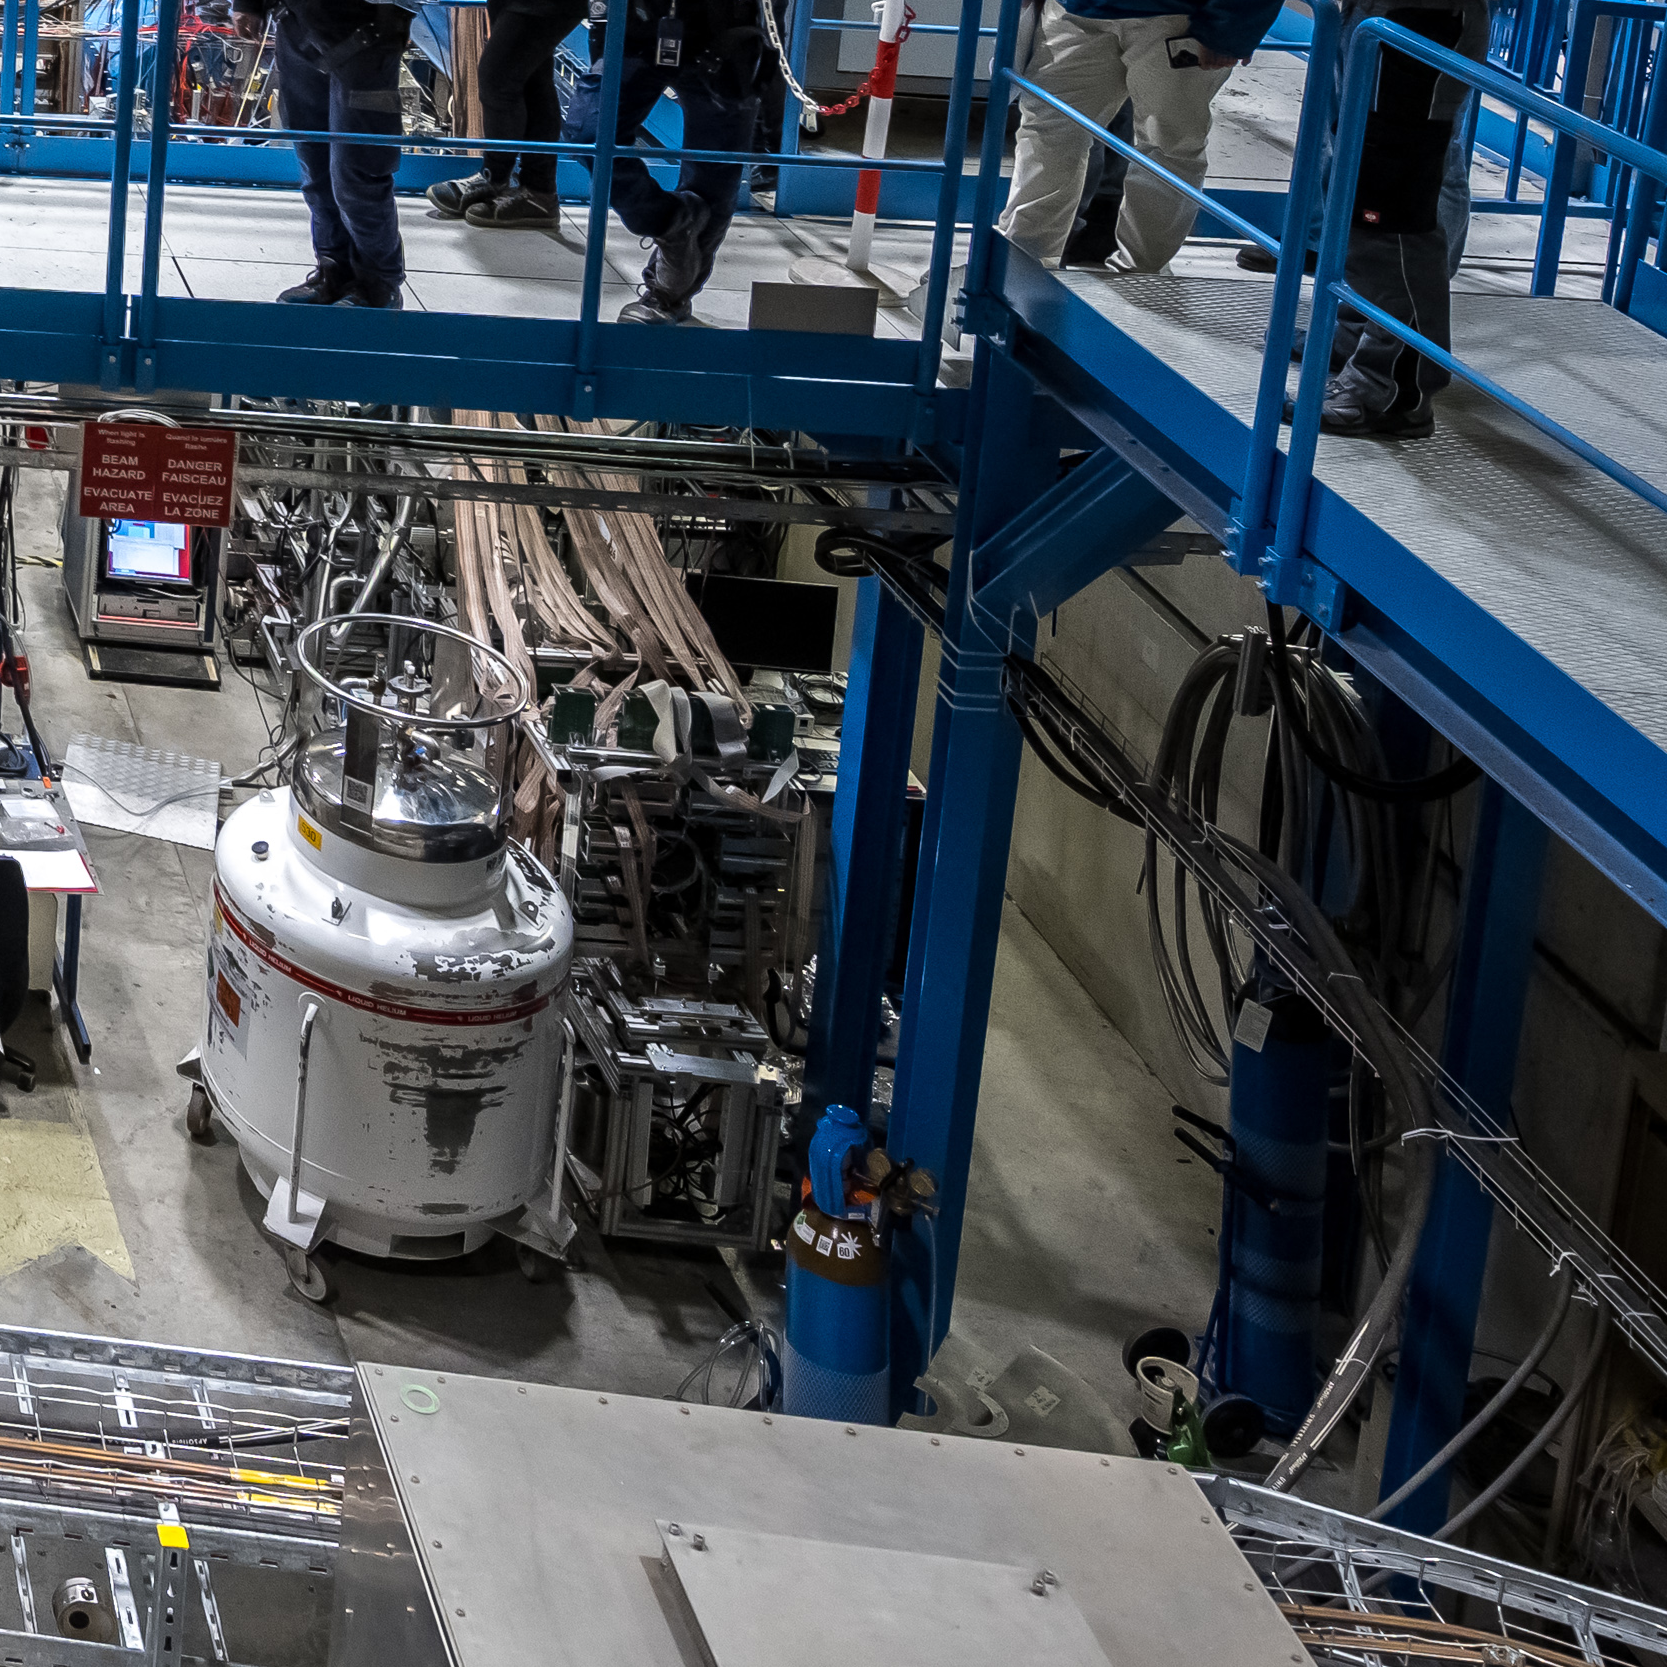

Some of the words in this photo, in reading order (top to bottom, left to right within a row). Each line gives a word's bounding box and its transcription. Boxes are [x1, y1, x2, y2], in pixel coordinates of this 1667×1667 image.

[98, 428, 119, 437] When
[121, 430, 137, 439] light
[165, 434, 190, 443] Quand
[106, 437, 136, 447] flashing
[102, 454, 139, 466] BEAM
[168, 459, 223, 472] DANGER
[92, 467, 146, 480] HAZARD
[162, 472, 227, 486] FAISCEAU
[83, 486, 152, 501] EVACUATE
[162, 492, 223, 506] EVACUEZ
[99, 501, 135, 513] AREA
[164, 506, 181, 516] LA
[184, 508, 219, 519] ZONE
[248, 940, 267, 958] LIQUID
[267, 953, 292, 974] HELIUM
[347, 994, 374, 1009] LIQUID
[376, 1002, 407, 1017] HELIUM
[467, 1012, 492, 1023] LIQUID
[492, 1010, 518, 1022] HELIUM
[839, 1246, 850, 1257] 60
[1291, 1413, 1316, 1448] UNIVERSAL
